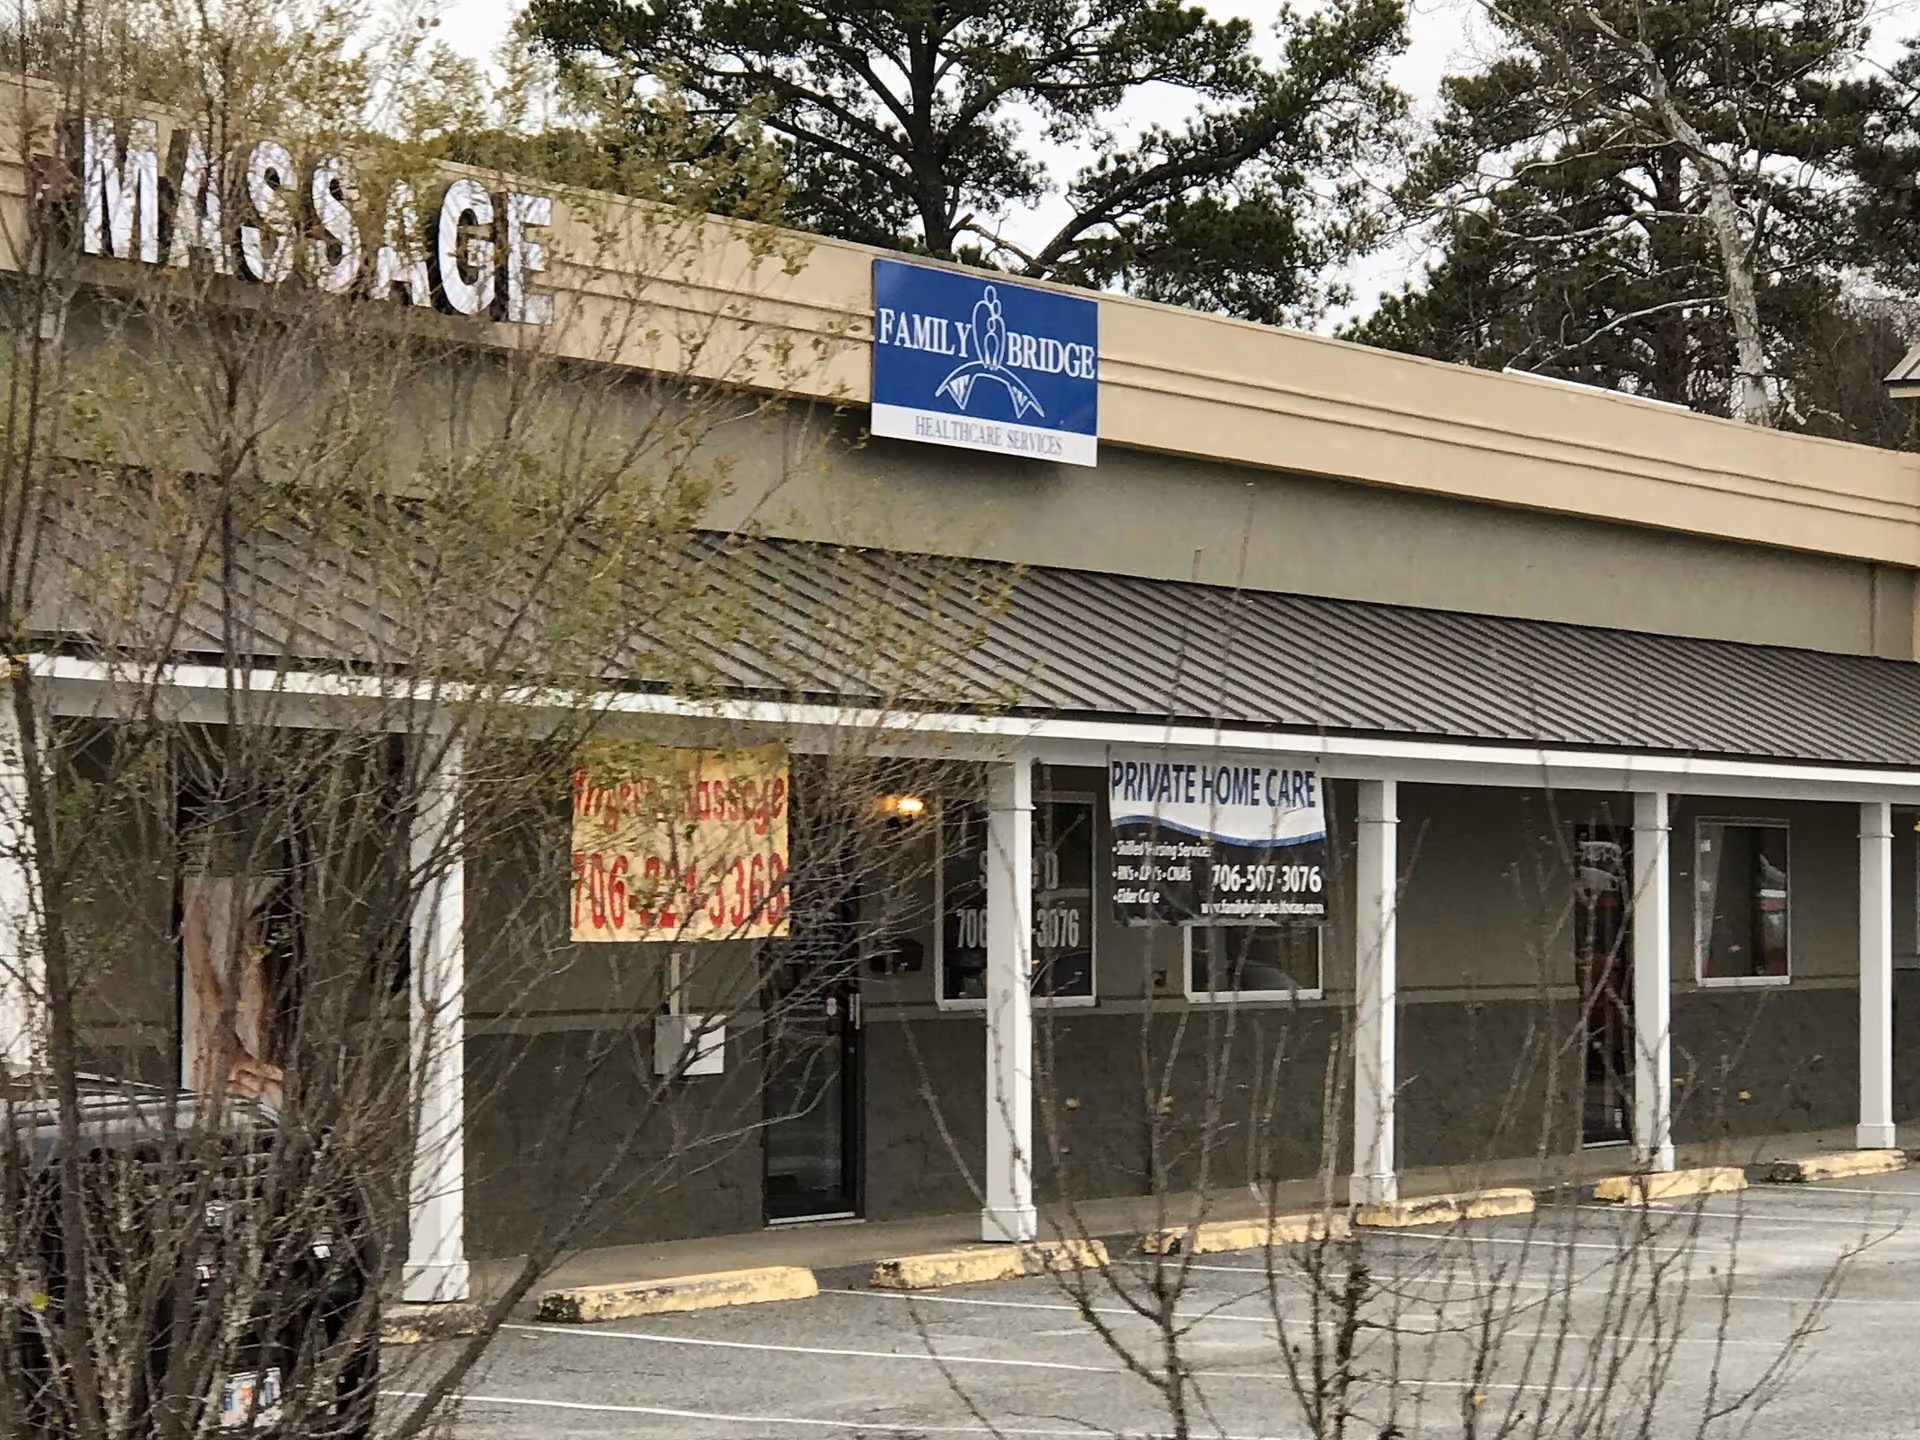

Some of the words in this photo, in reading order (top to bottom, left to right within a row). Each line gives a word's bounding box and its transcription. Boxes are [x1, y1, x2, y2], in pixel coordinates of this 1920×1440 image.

[83, 114, 555, 326] MASSAGE
[878, 307, 972, 358] FAMILY
[1006, 331, 1095, 380] BRIDGE
[915, 415, 1001, 447] HEALTHCARE
[1006, 429, 1062, 456] SERVICES
[1112, 760, 1196, 804] PRIVATE
[1201, 765, 1260, 806] HOME
[1266, 768, 1316, 808] CARE
[1211, 864, 1323, 894] 706-507-3076
